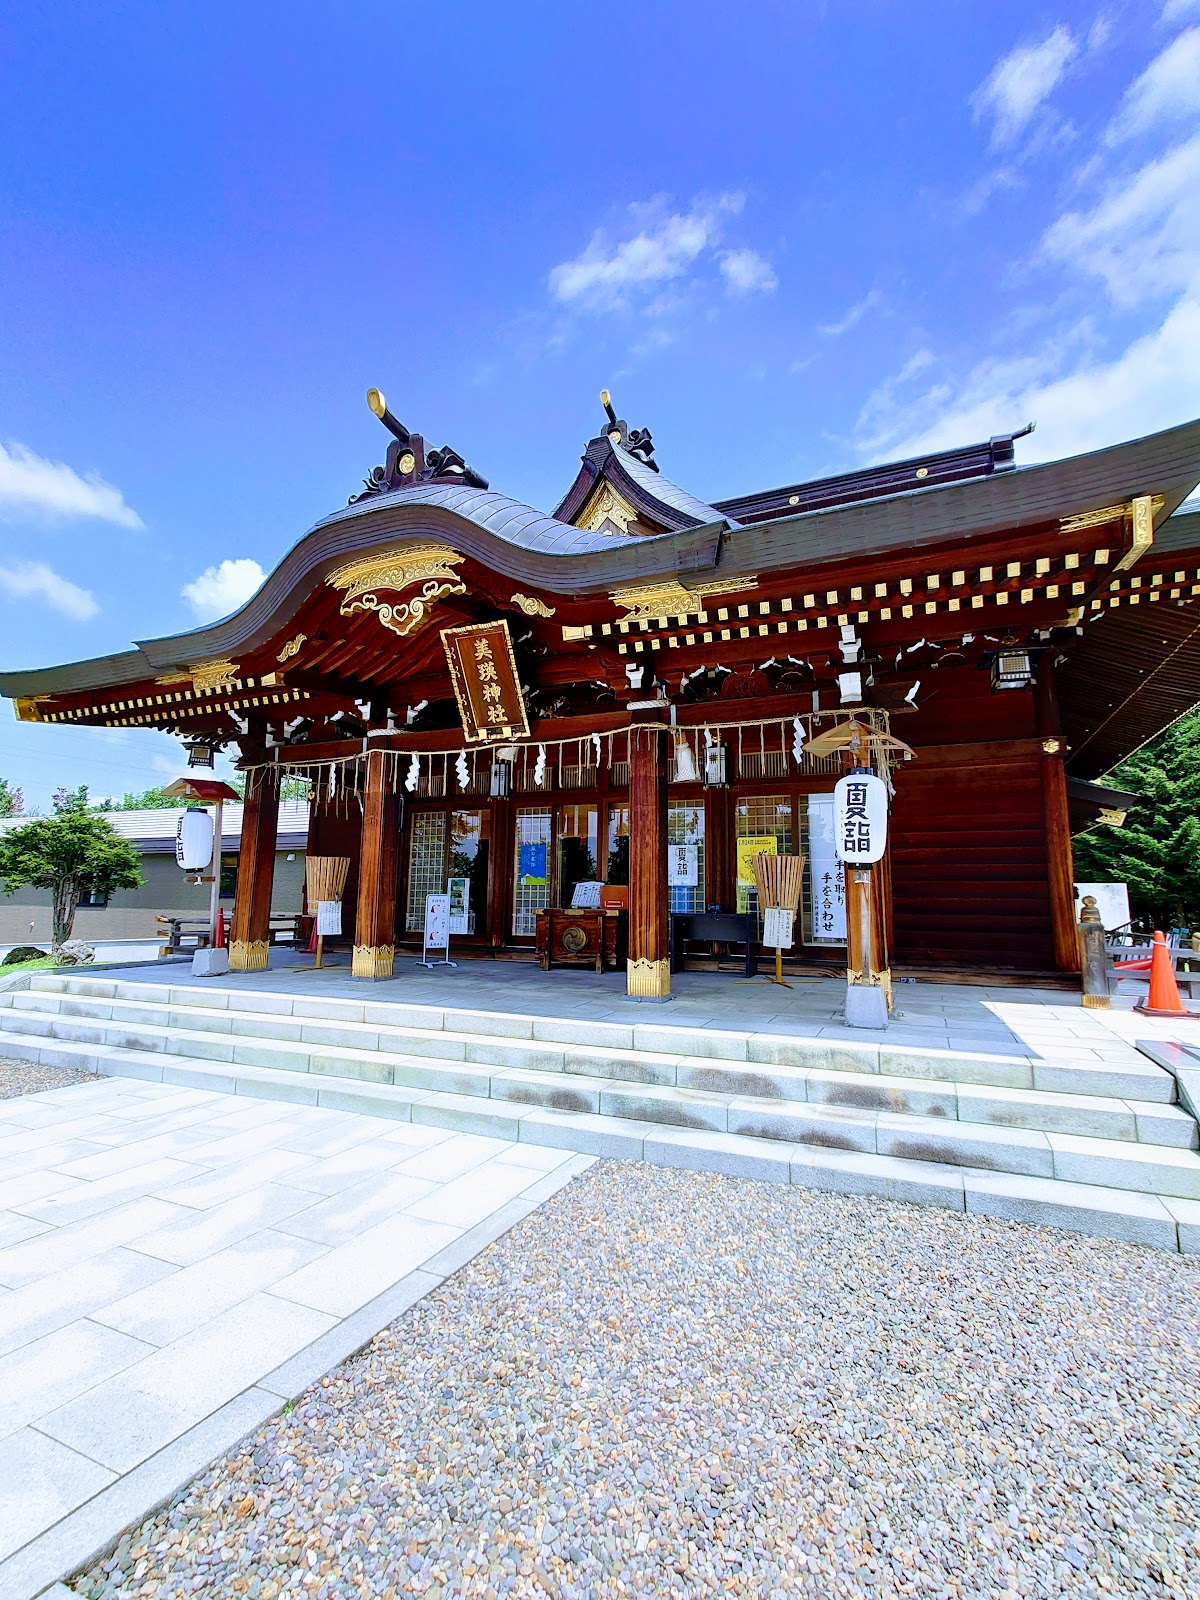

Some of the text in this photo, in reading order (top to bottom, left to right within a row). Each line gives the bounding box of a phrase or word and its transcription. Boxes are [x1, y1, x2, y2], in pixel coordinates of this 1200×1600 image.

[473, 637, 508, 724] 美瑛神社
[844, 782, 871, 853] 夏詣
[821, 871, 834, 932] 手を合わせ
[834, 849, 845, 906] 手を取り
